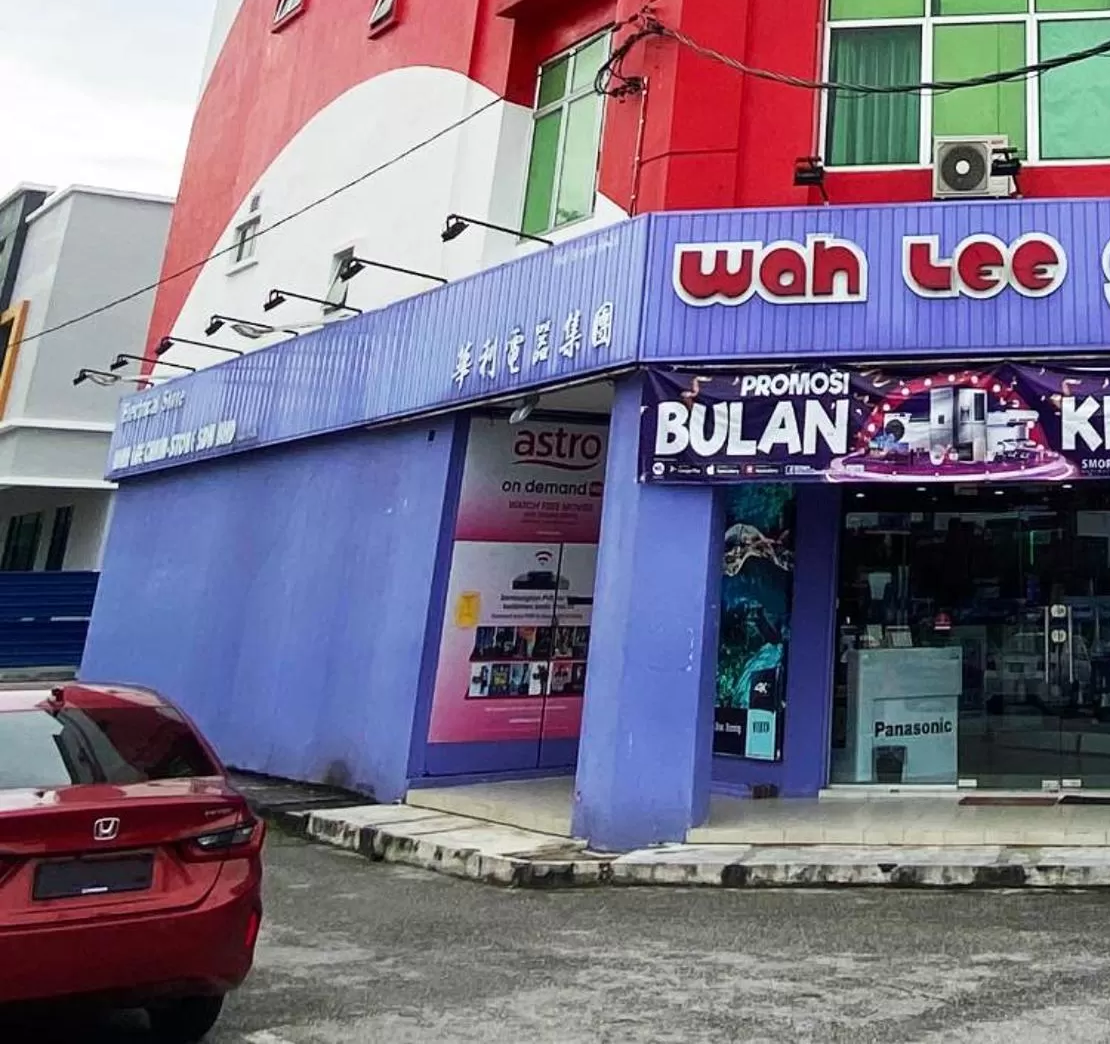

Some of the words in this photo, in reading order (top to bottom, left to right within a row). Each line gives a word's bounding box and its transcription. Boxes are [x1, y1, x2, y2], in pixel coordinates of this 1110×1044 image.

[740, 370, 850, 397] PROMOSI
[655, 398, 850, 457] BULAN
[513, 427, 602, 460] astro
[502, 480, 521, 493] on
[525, 479, 587, 496] demand
[874, 717, 952, 738] Panasonic
